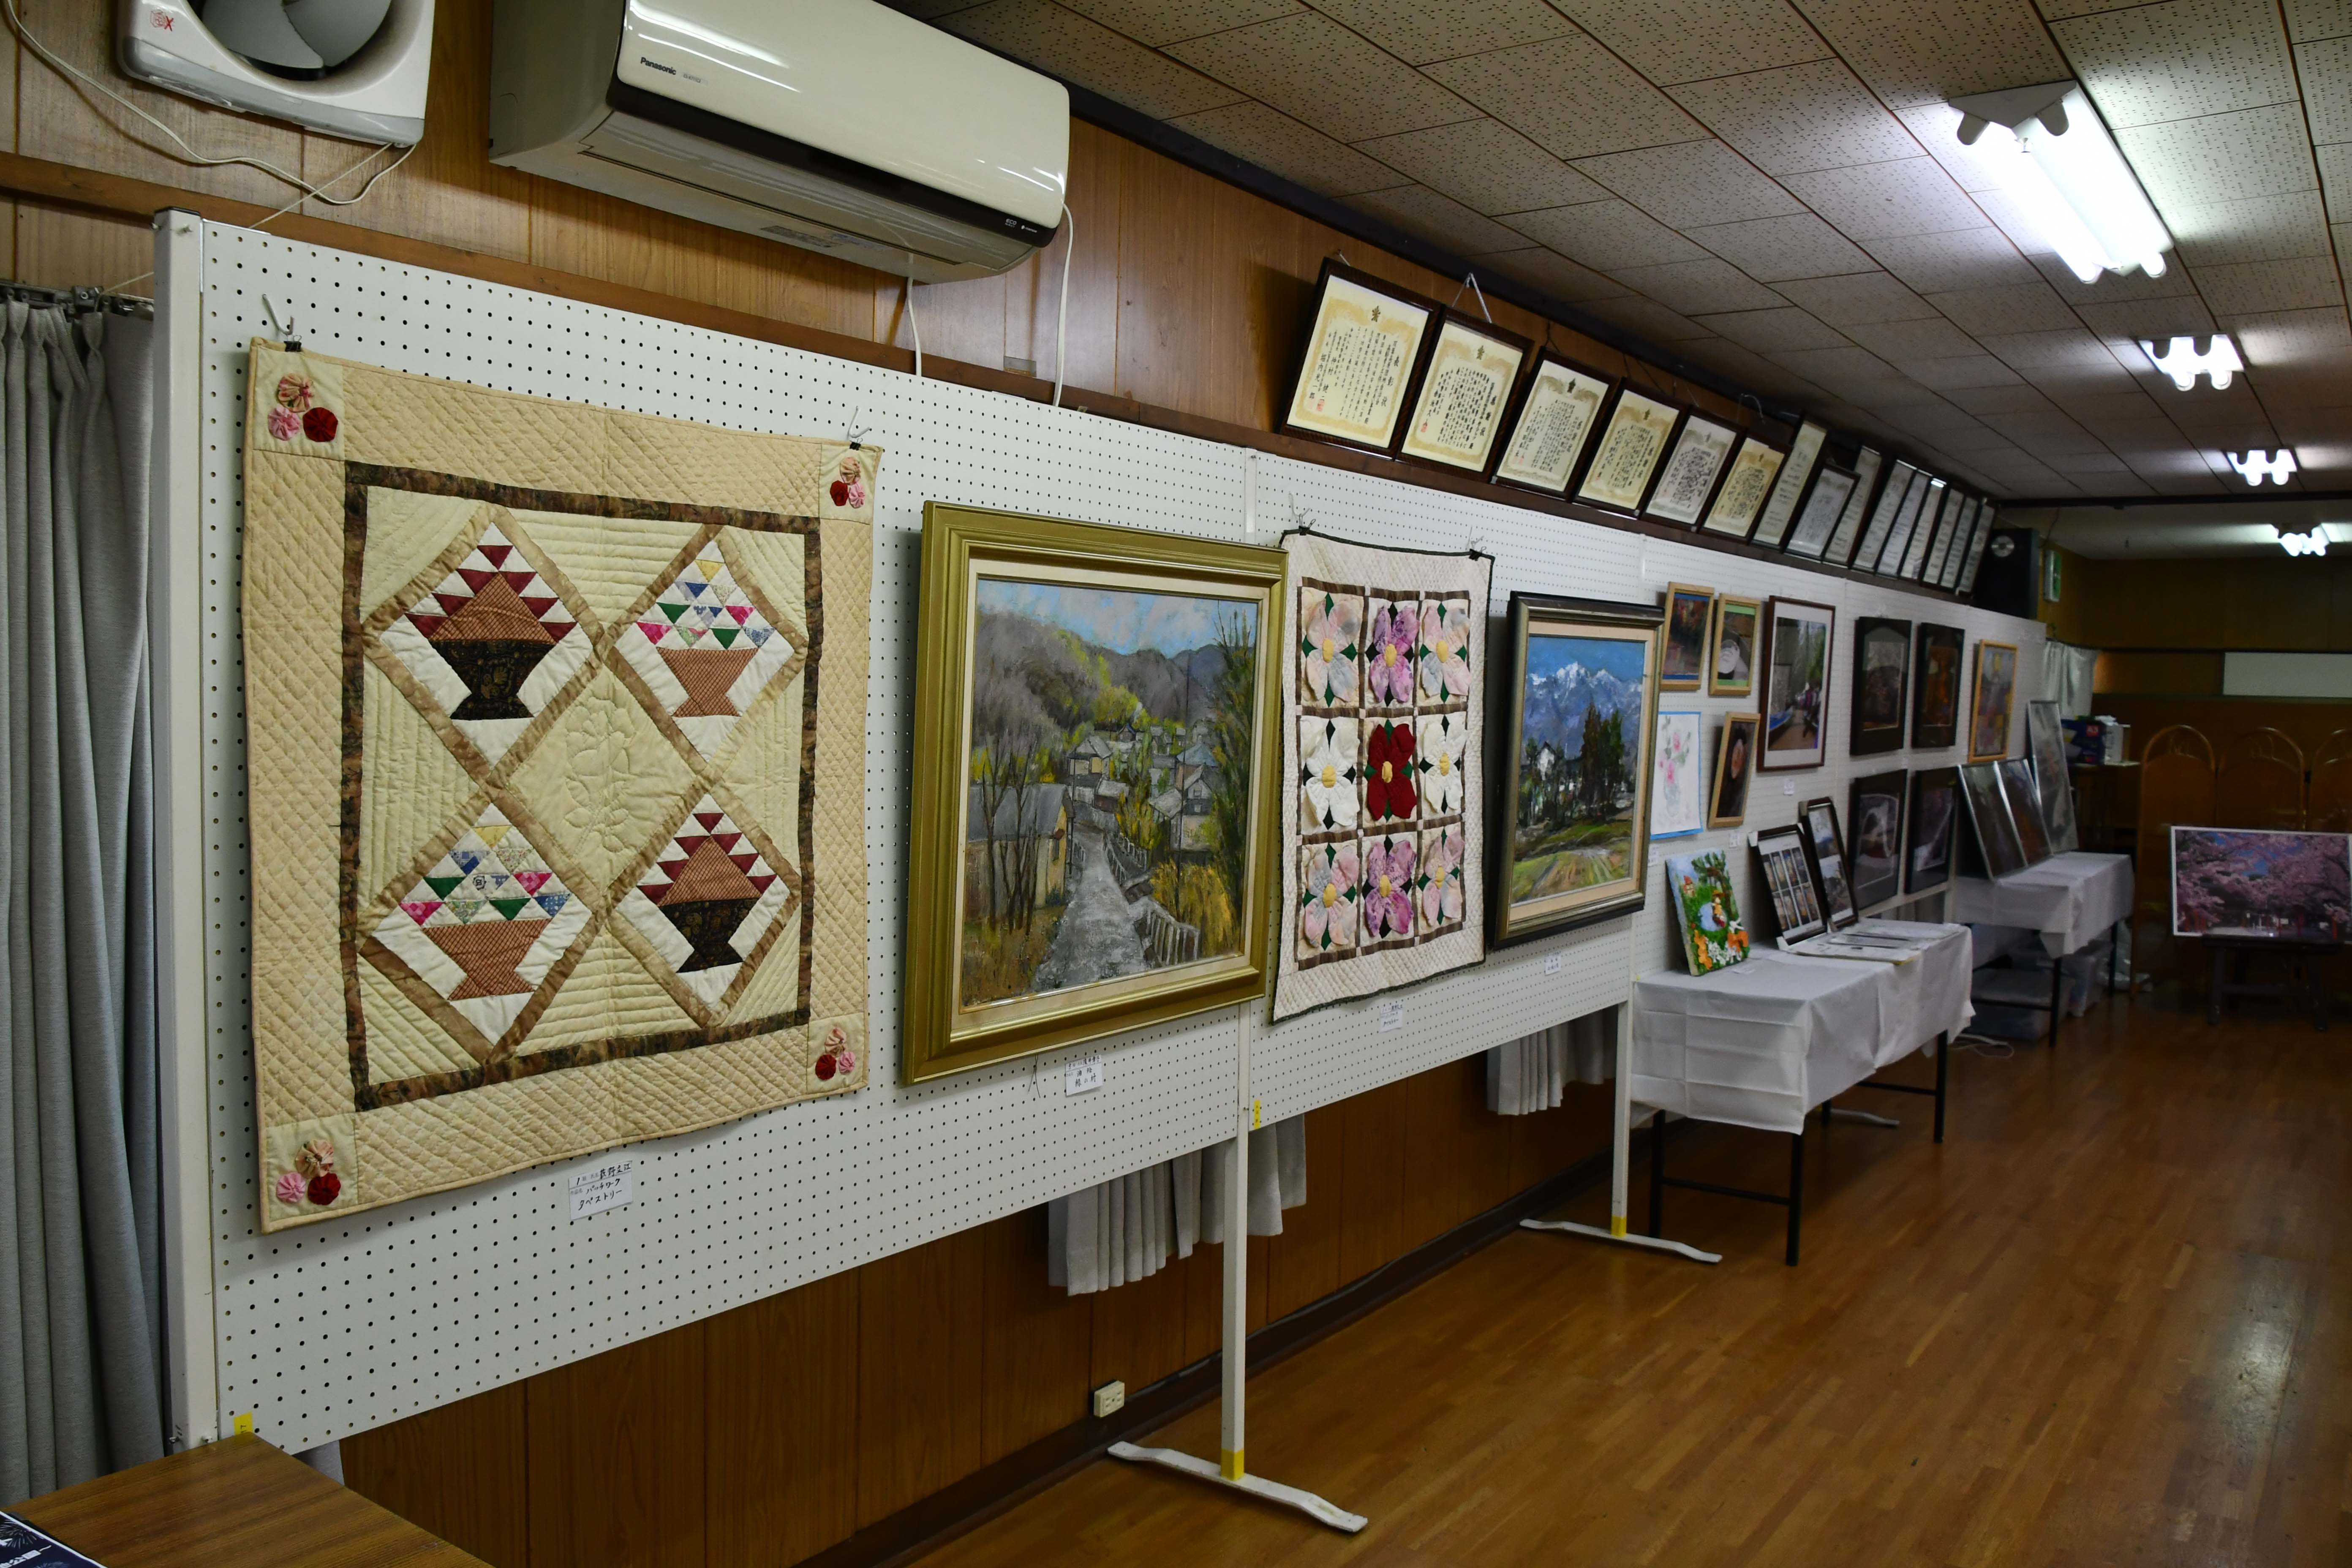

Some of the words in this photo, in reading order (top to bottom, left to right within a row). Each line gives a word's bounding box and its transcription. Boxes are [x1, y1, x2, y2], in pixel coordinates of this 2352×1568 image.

[640, 57, 676, 75] Panasonic
[586, 1178, 621, 1195] パッチワーク
[578, 1190, 622, 1211] タペストリー
